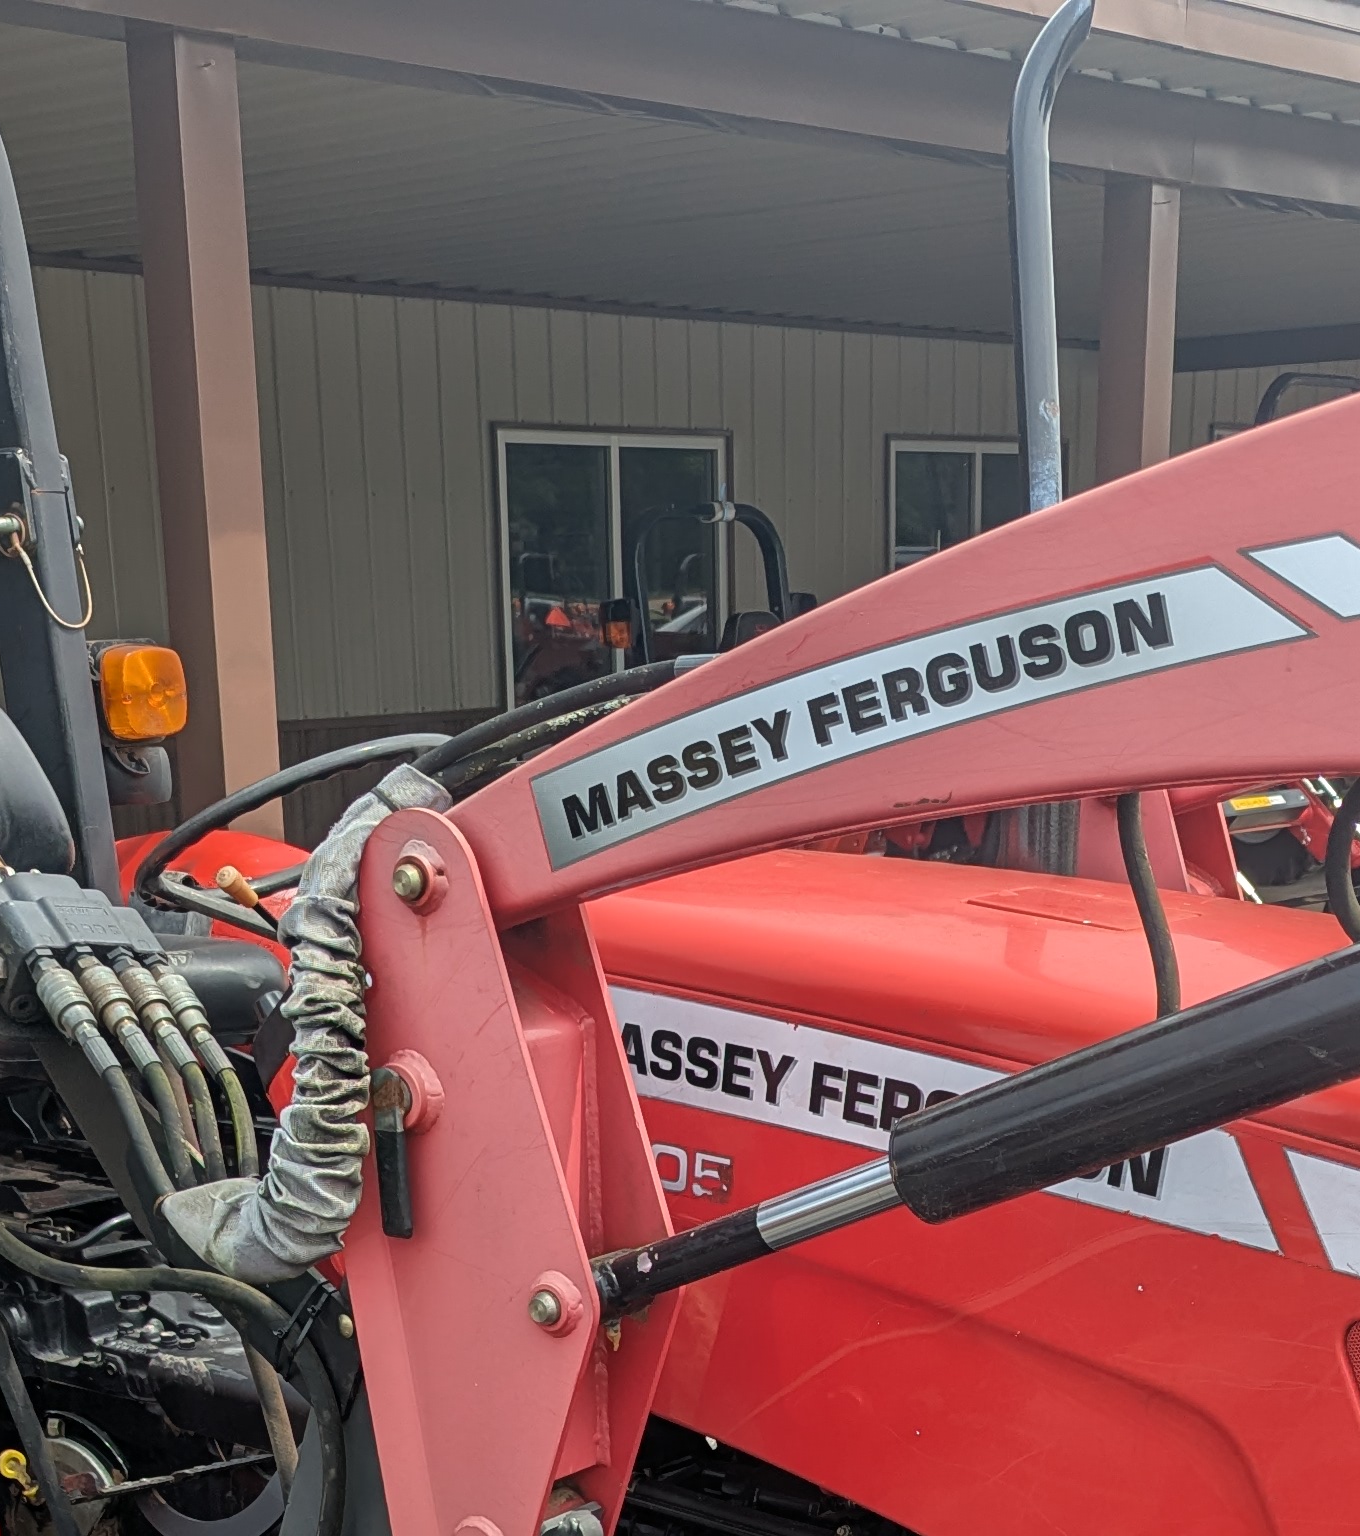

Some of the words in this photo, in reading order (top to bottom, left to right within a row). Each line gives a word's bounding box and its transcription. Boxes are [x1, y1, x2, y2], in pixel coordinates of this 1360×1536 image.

[560, 708, 791, 841] MASSEY
[806, 591, 1174, 747] FERGUSON
[620, 1022, 798, 1107] ASSEY
